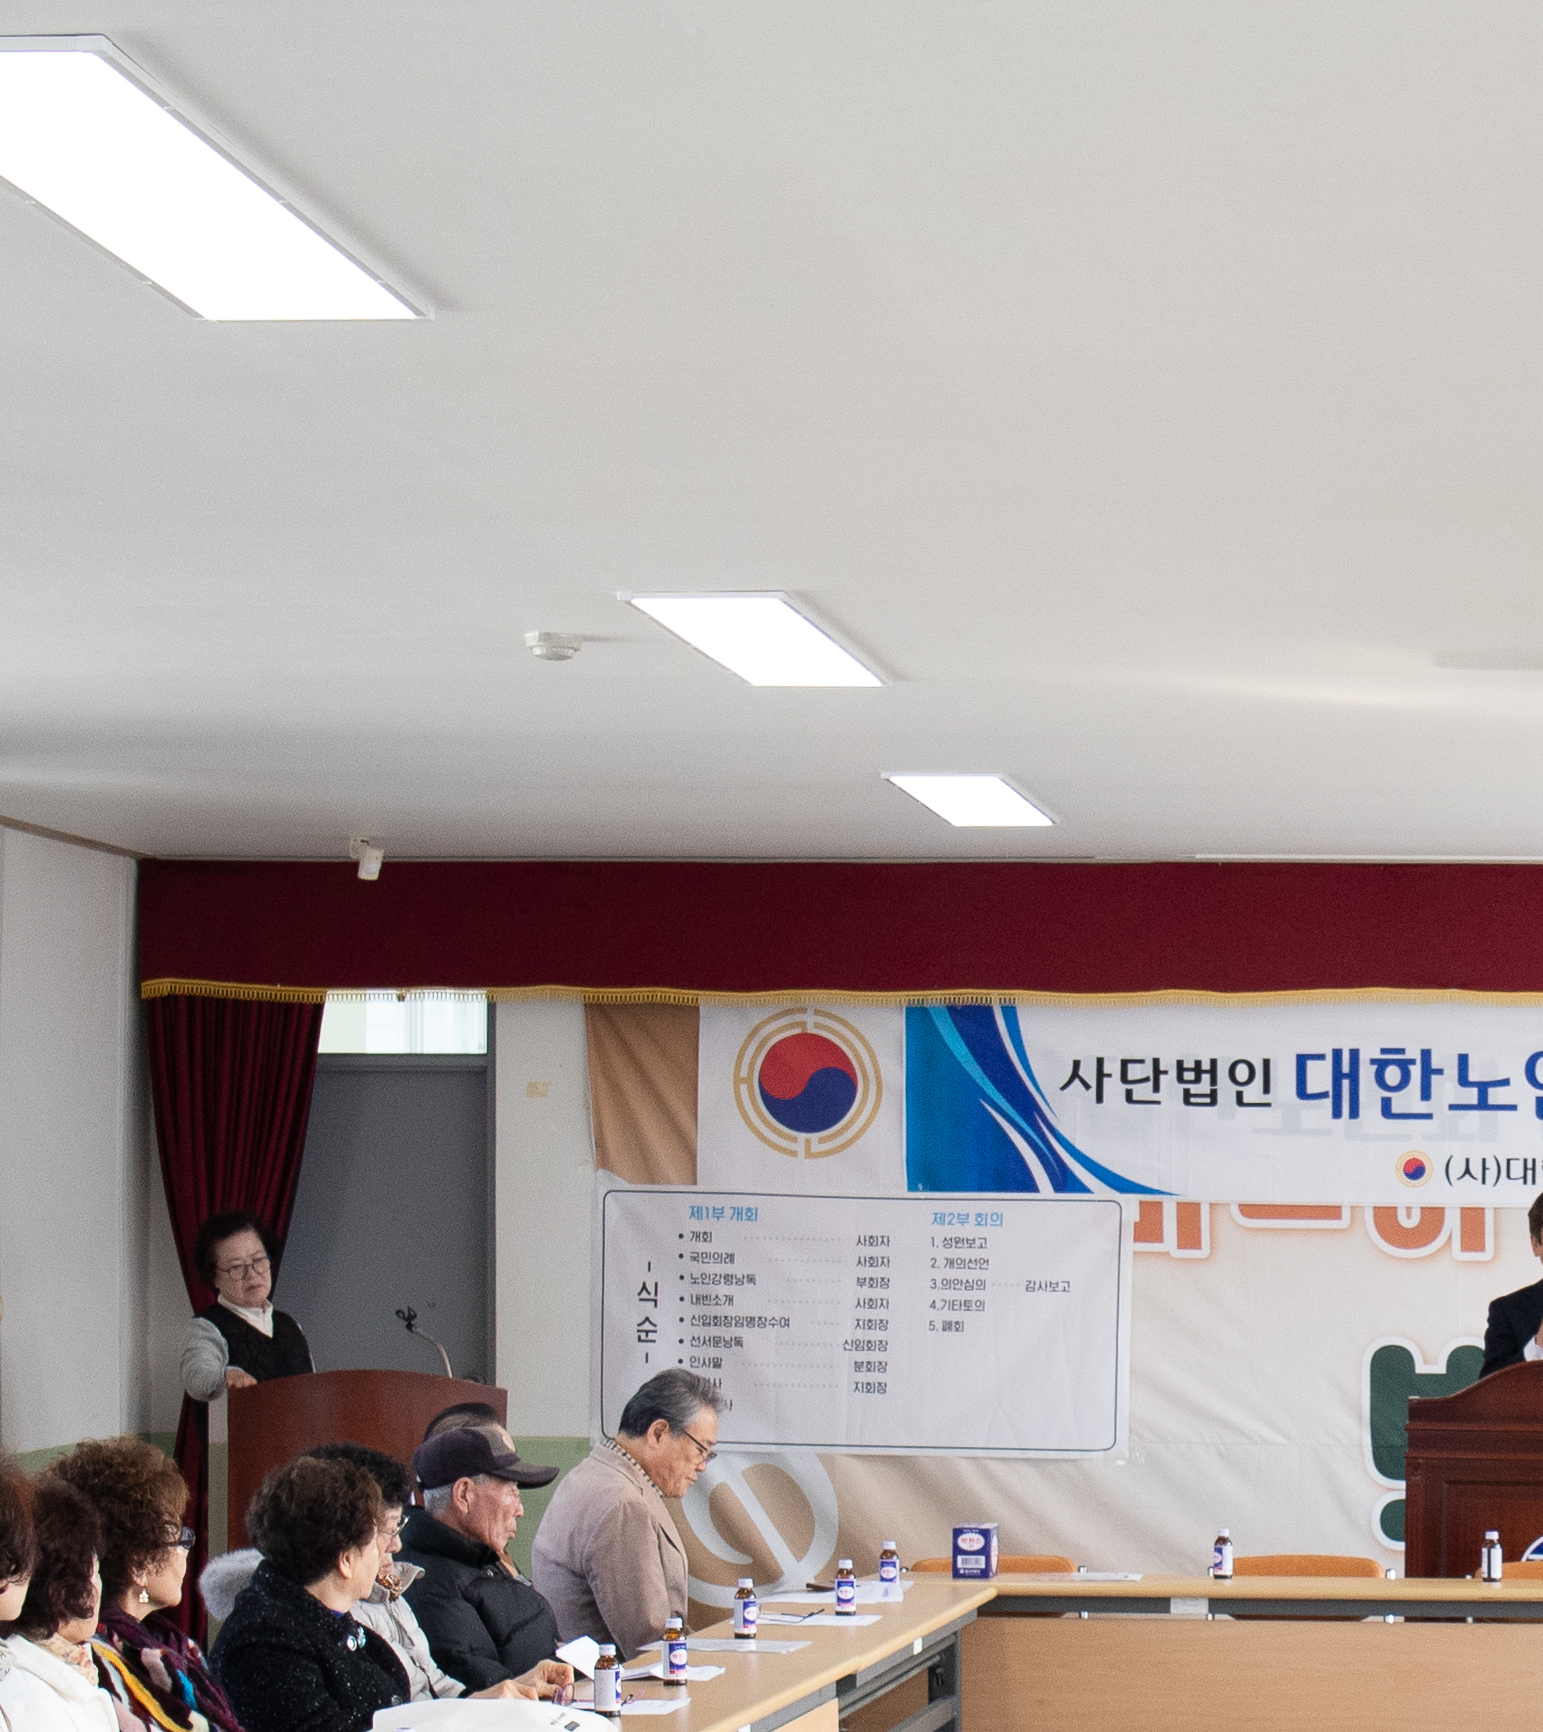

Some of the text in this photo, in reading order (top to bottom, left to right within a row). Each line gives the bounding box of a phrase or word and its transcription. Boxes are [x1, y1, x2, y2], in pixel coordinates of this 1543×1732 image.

[1058, 1055, 1274, 1107] 사단법인
[688, 1205, 758, 1222] 제1부 개회
[931, 1212, 1004, 1227] 제2부 회의
[689, 1230, 891, 1248] 개회 사회자
[930, 1236, 988, 1249] 1. 성원보고
[689, 1251, 891, 1269] 국민의례 사회자
[930, 1257, 990, 1271] 2. 개의선언
[689, 1272, 891, 1290] 노인강령낭독 부회장
[1025, 1280, 1072, 1293] 감사보고
[689, 1294, 890, 1311] 내빈소개 사회자
[854, 1318, 889, 1332] 지회장
[928, 1320, 965, 1333] 5. 폐회
[689, 1336, 889, 1353] 선서문낭독 신임회장
[688, 1356, 888, 1374] 인사말 분회장
[853, 1381, 888, 1395] 지회장
